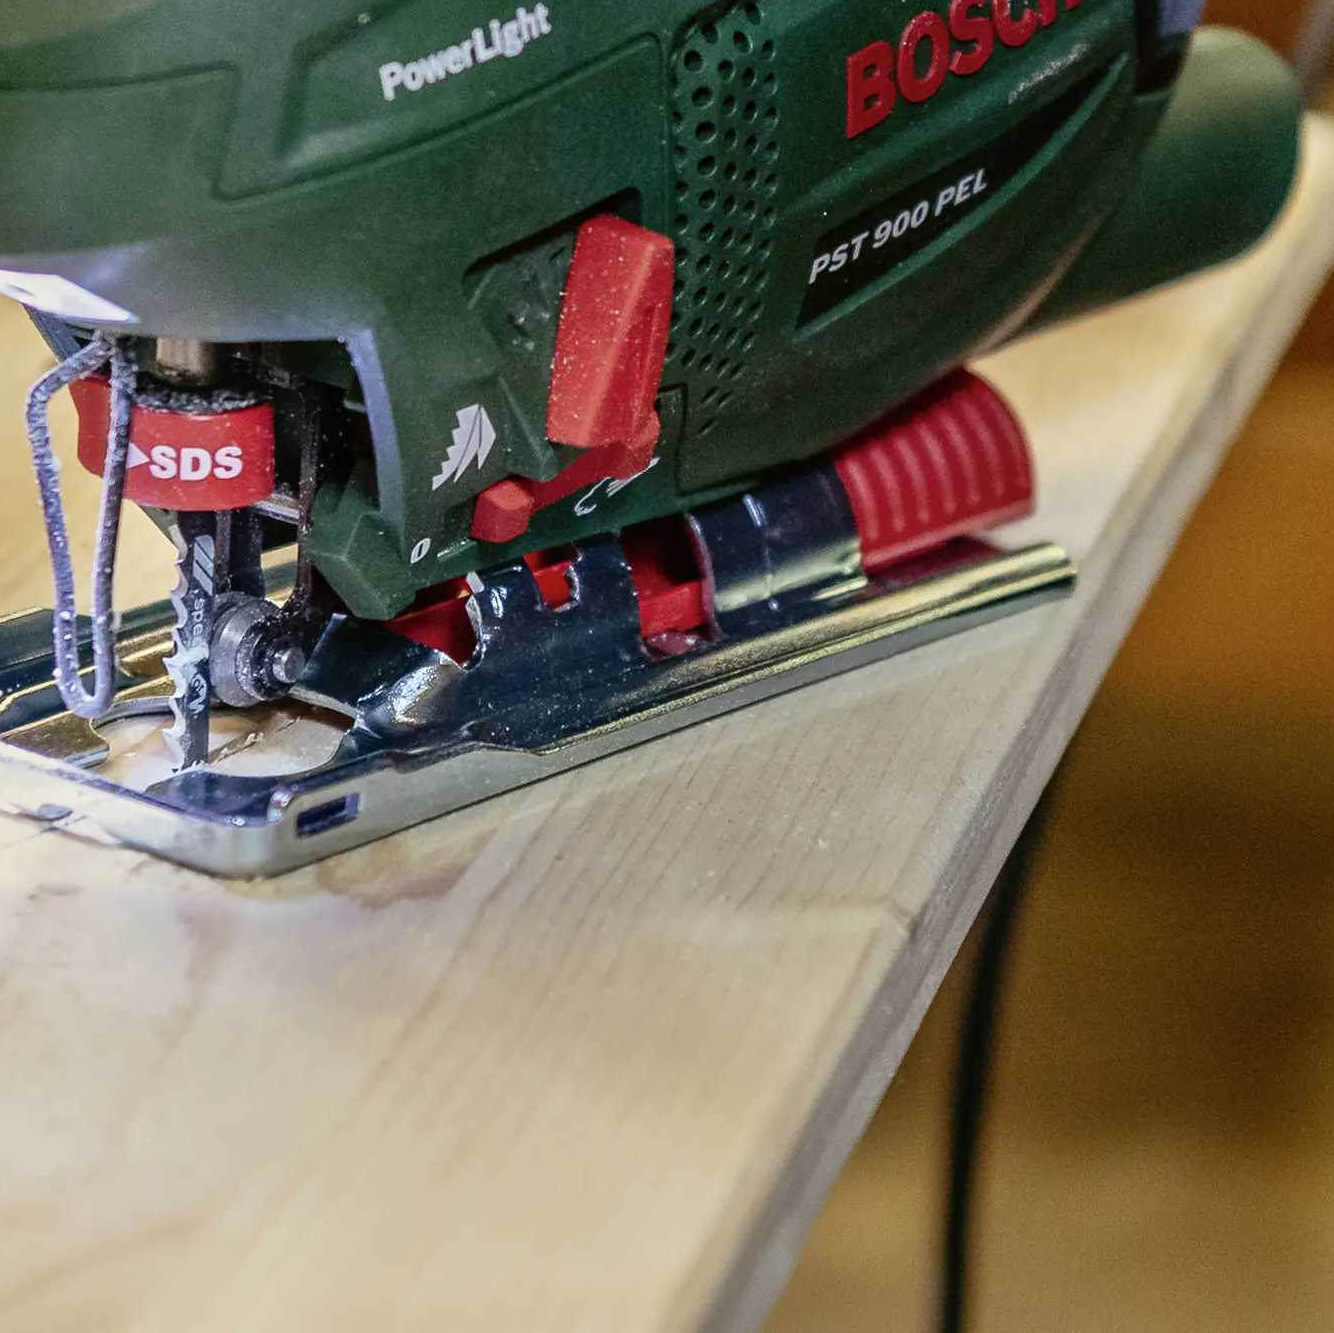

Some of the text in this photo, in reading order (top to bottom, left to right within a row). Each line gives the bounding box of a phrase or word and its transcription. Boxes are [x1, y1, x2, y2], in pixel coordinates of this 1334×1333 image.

[379, 2, 552, 101] PowerLight
[808, 168, 987, 285] PST 900 PEL
[149, 445, 243, 481] SDS
